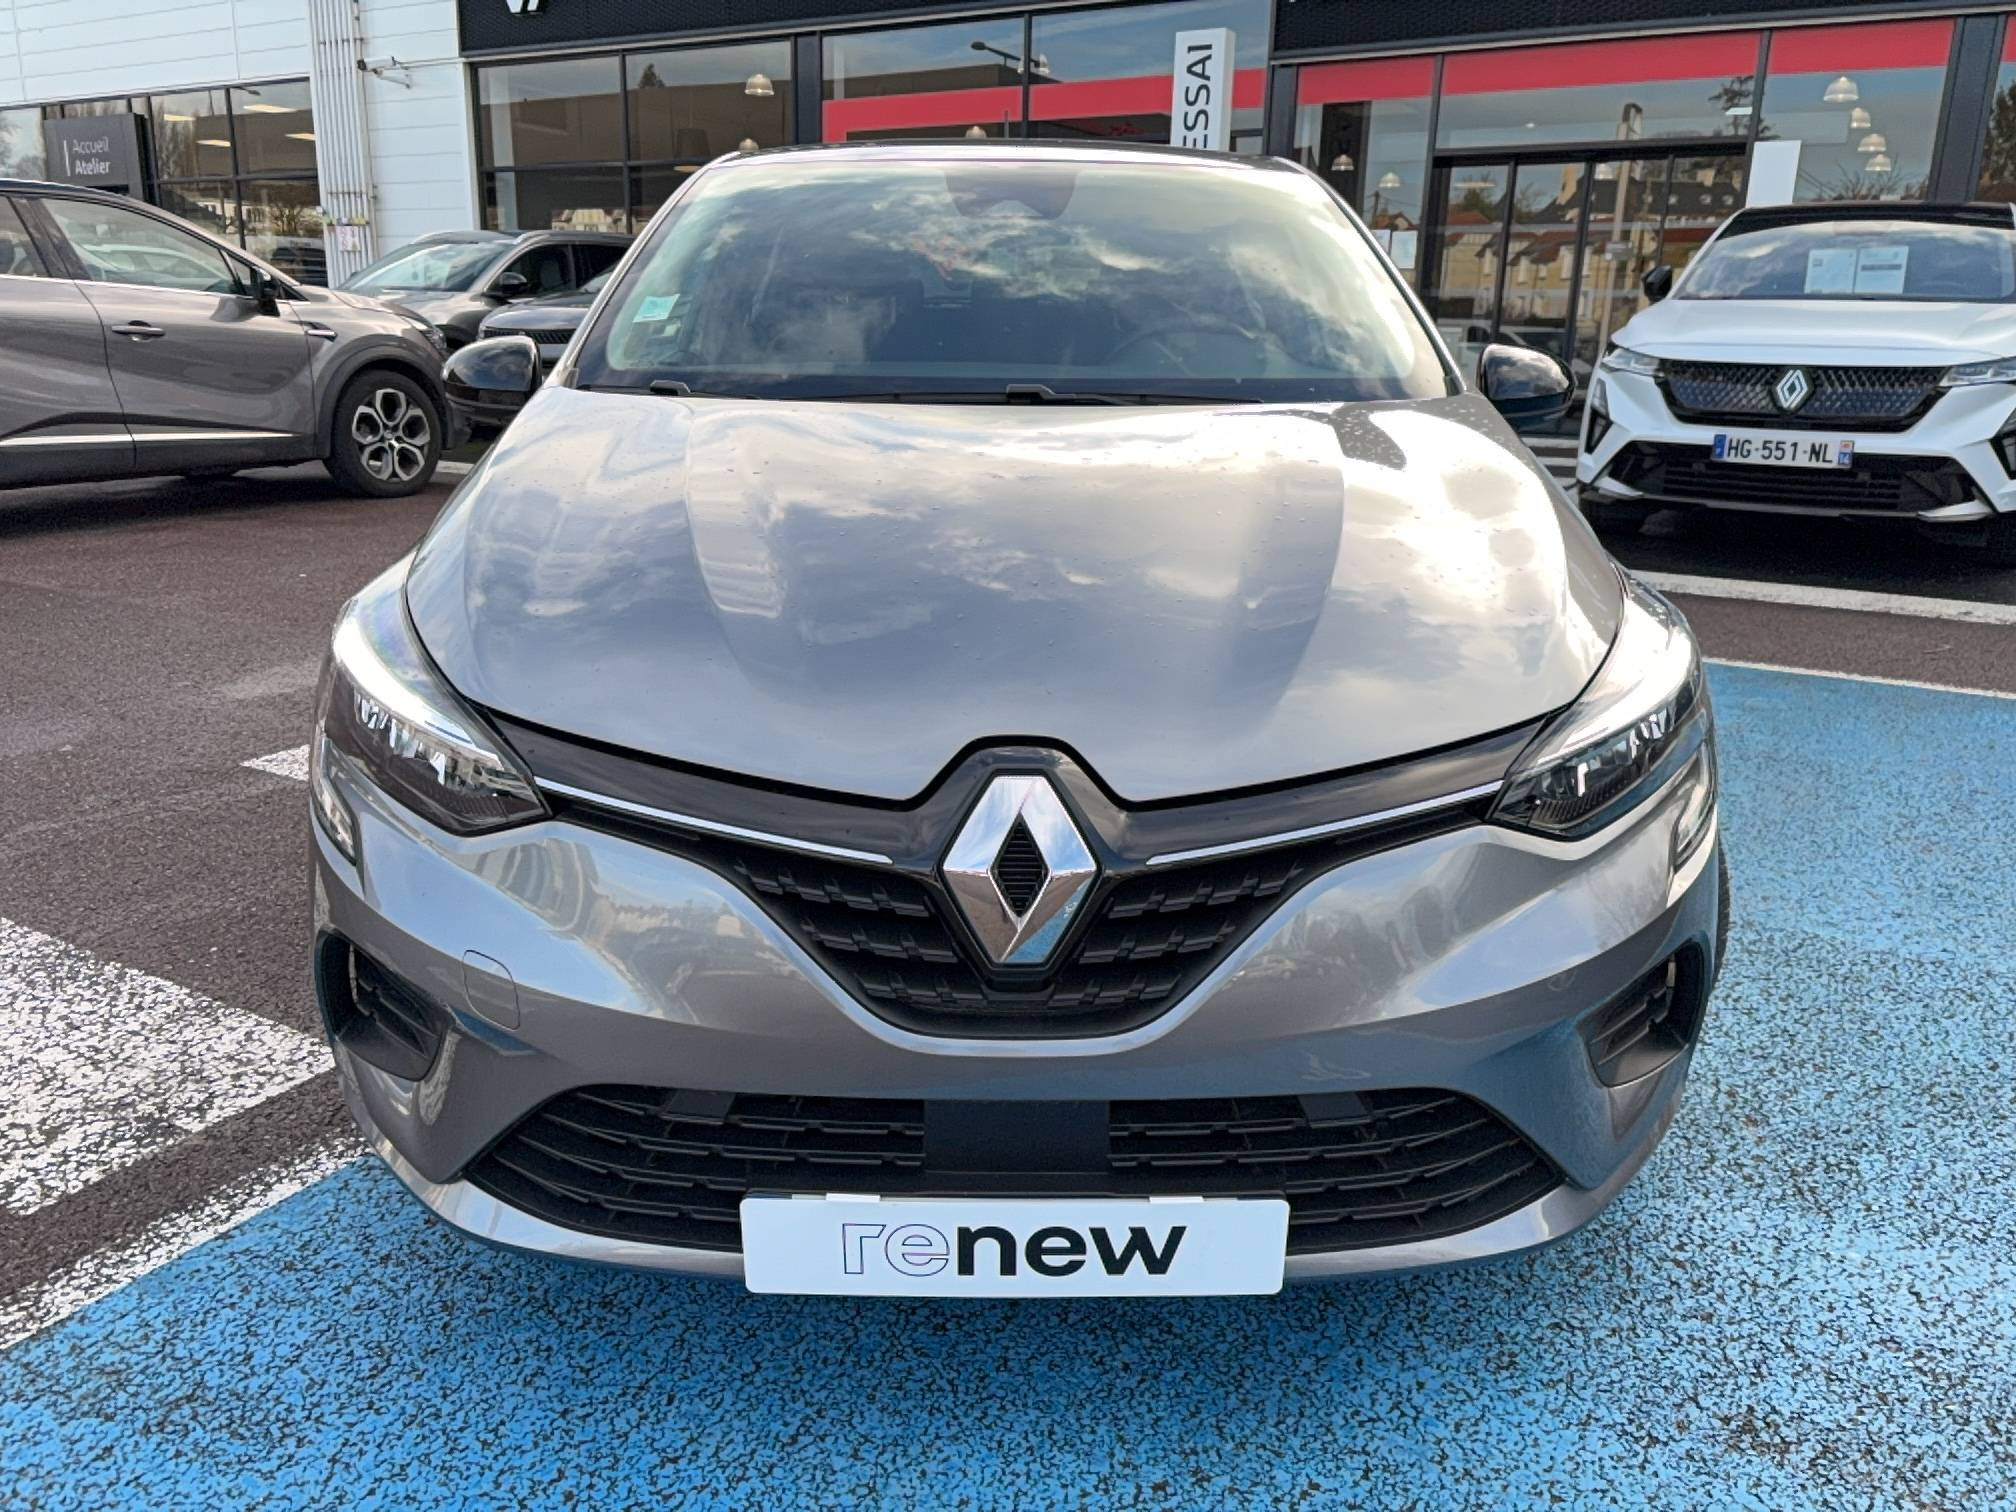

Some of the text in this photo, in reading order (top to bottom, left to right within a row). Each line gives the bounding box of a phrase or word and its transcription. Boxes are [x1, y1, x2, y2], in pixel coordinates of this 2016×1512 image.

[1183, 44, 1212, 149] ESSAI
[73, 136, 109, 154] Accueil
[75, 157, 111, 175] Atelier
[842, 1223, 1187, 1277] renew
